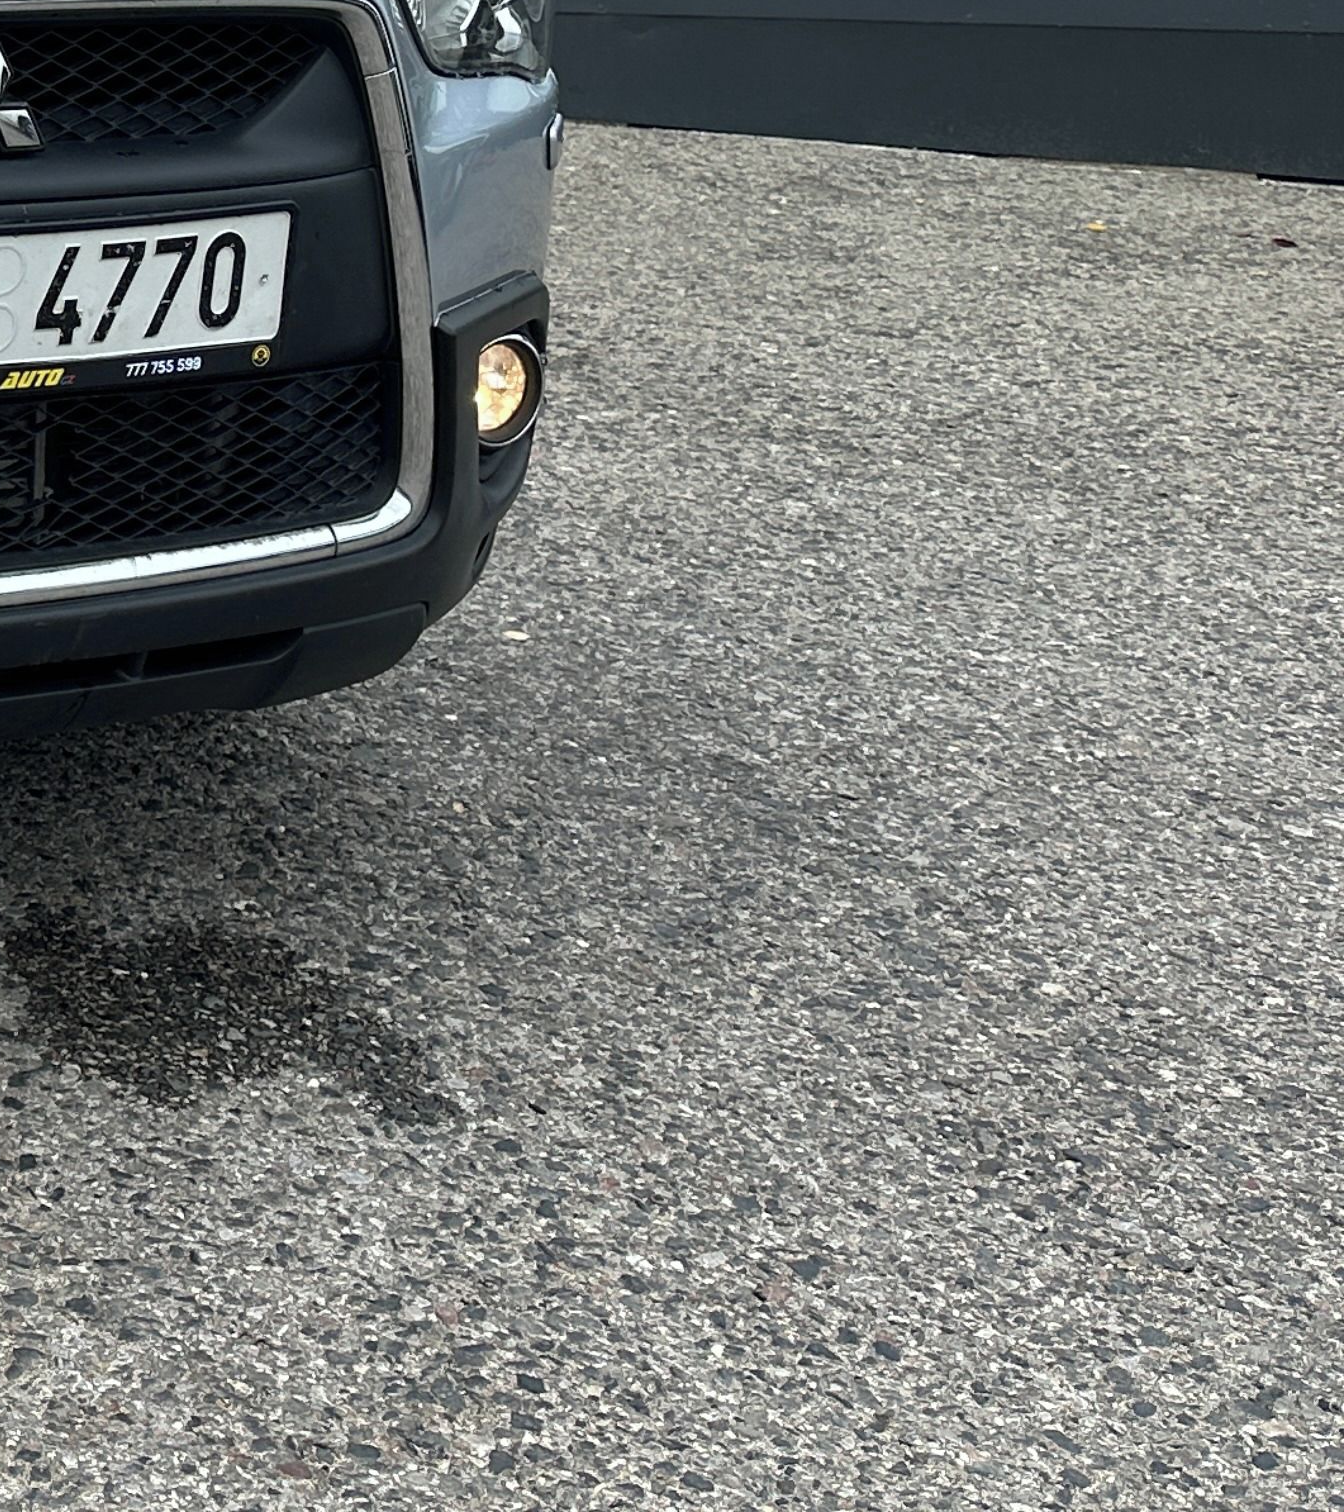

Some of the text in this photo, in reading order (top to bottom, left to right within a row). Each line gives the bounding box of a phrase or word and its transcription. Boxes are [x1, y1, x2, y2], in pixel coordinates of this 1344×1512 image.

[35, 231, 247, 346] 4770
[125, 356, 202, 377] 777 755 599
